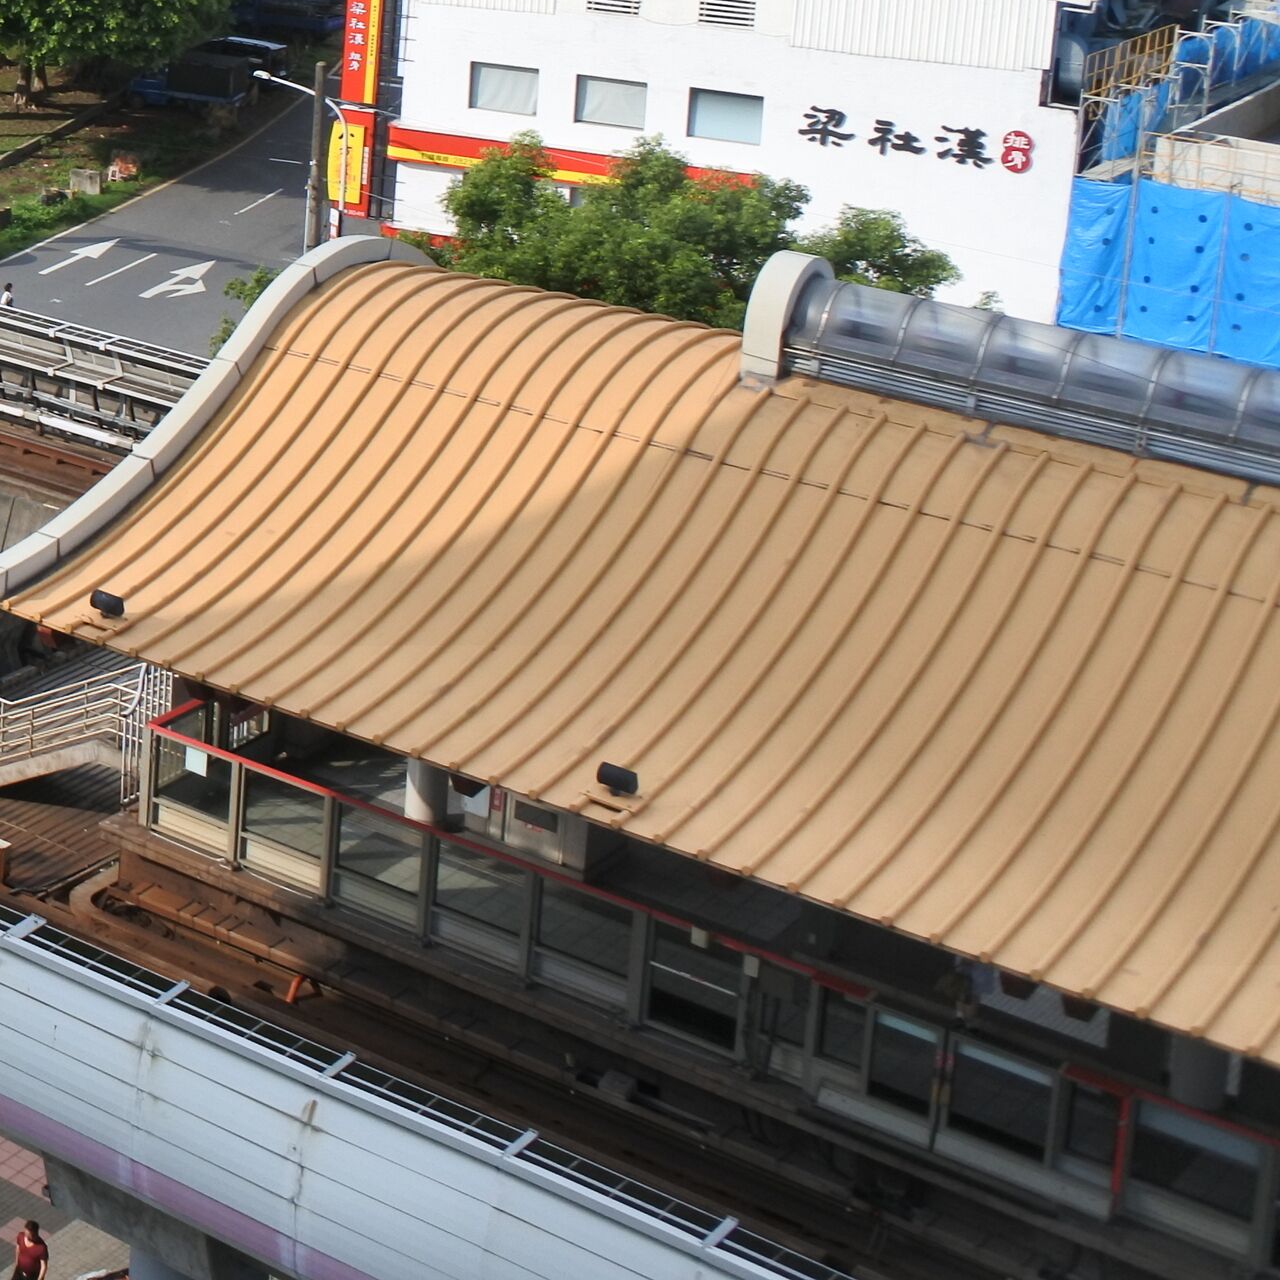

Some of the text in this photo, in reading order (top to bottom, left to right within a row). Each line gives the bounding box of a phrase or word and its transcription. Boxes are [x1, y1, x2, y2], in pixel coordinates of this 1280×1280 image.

[798, 105, 996, 169] 梁社漢
[1003, 132, 1030, 169] 排骨
